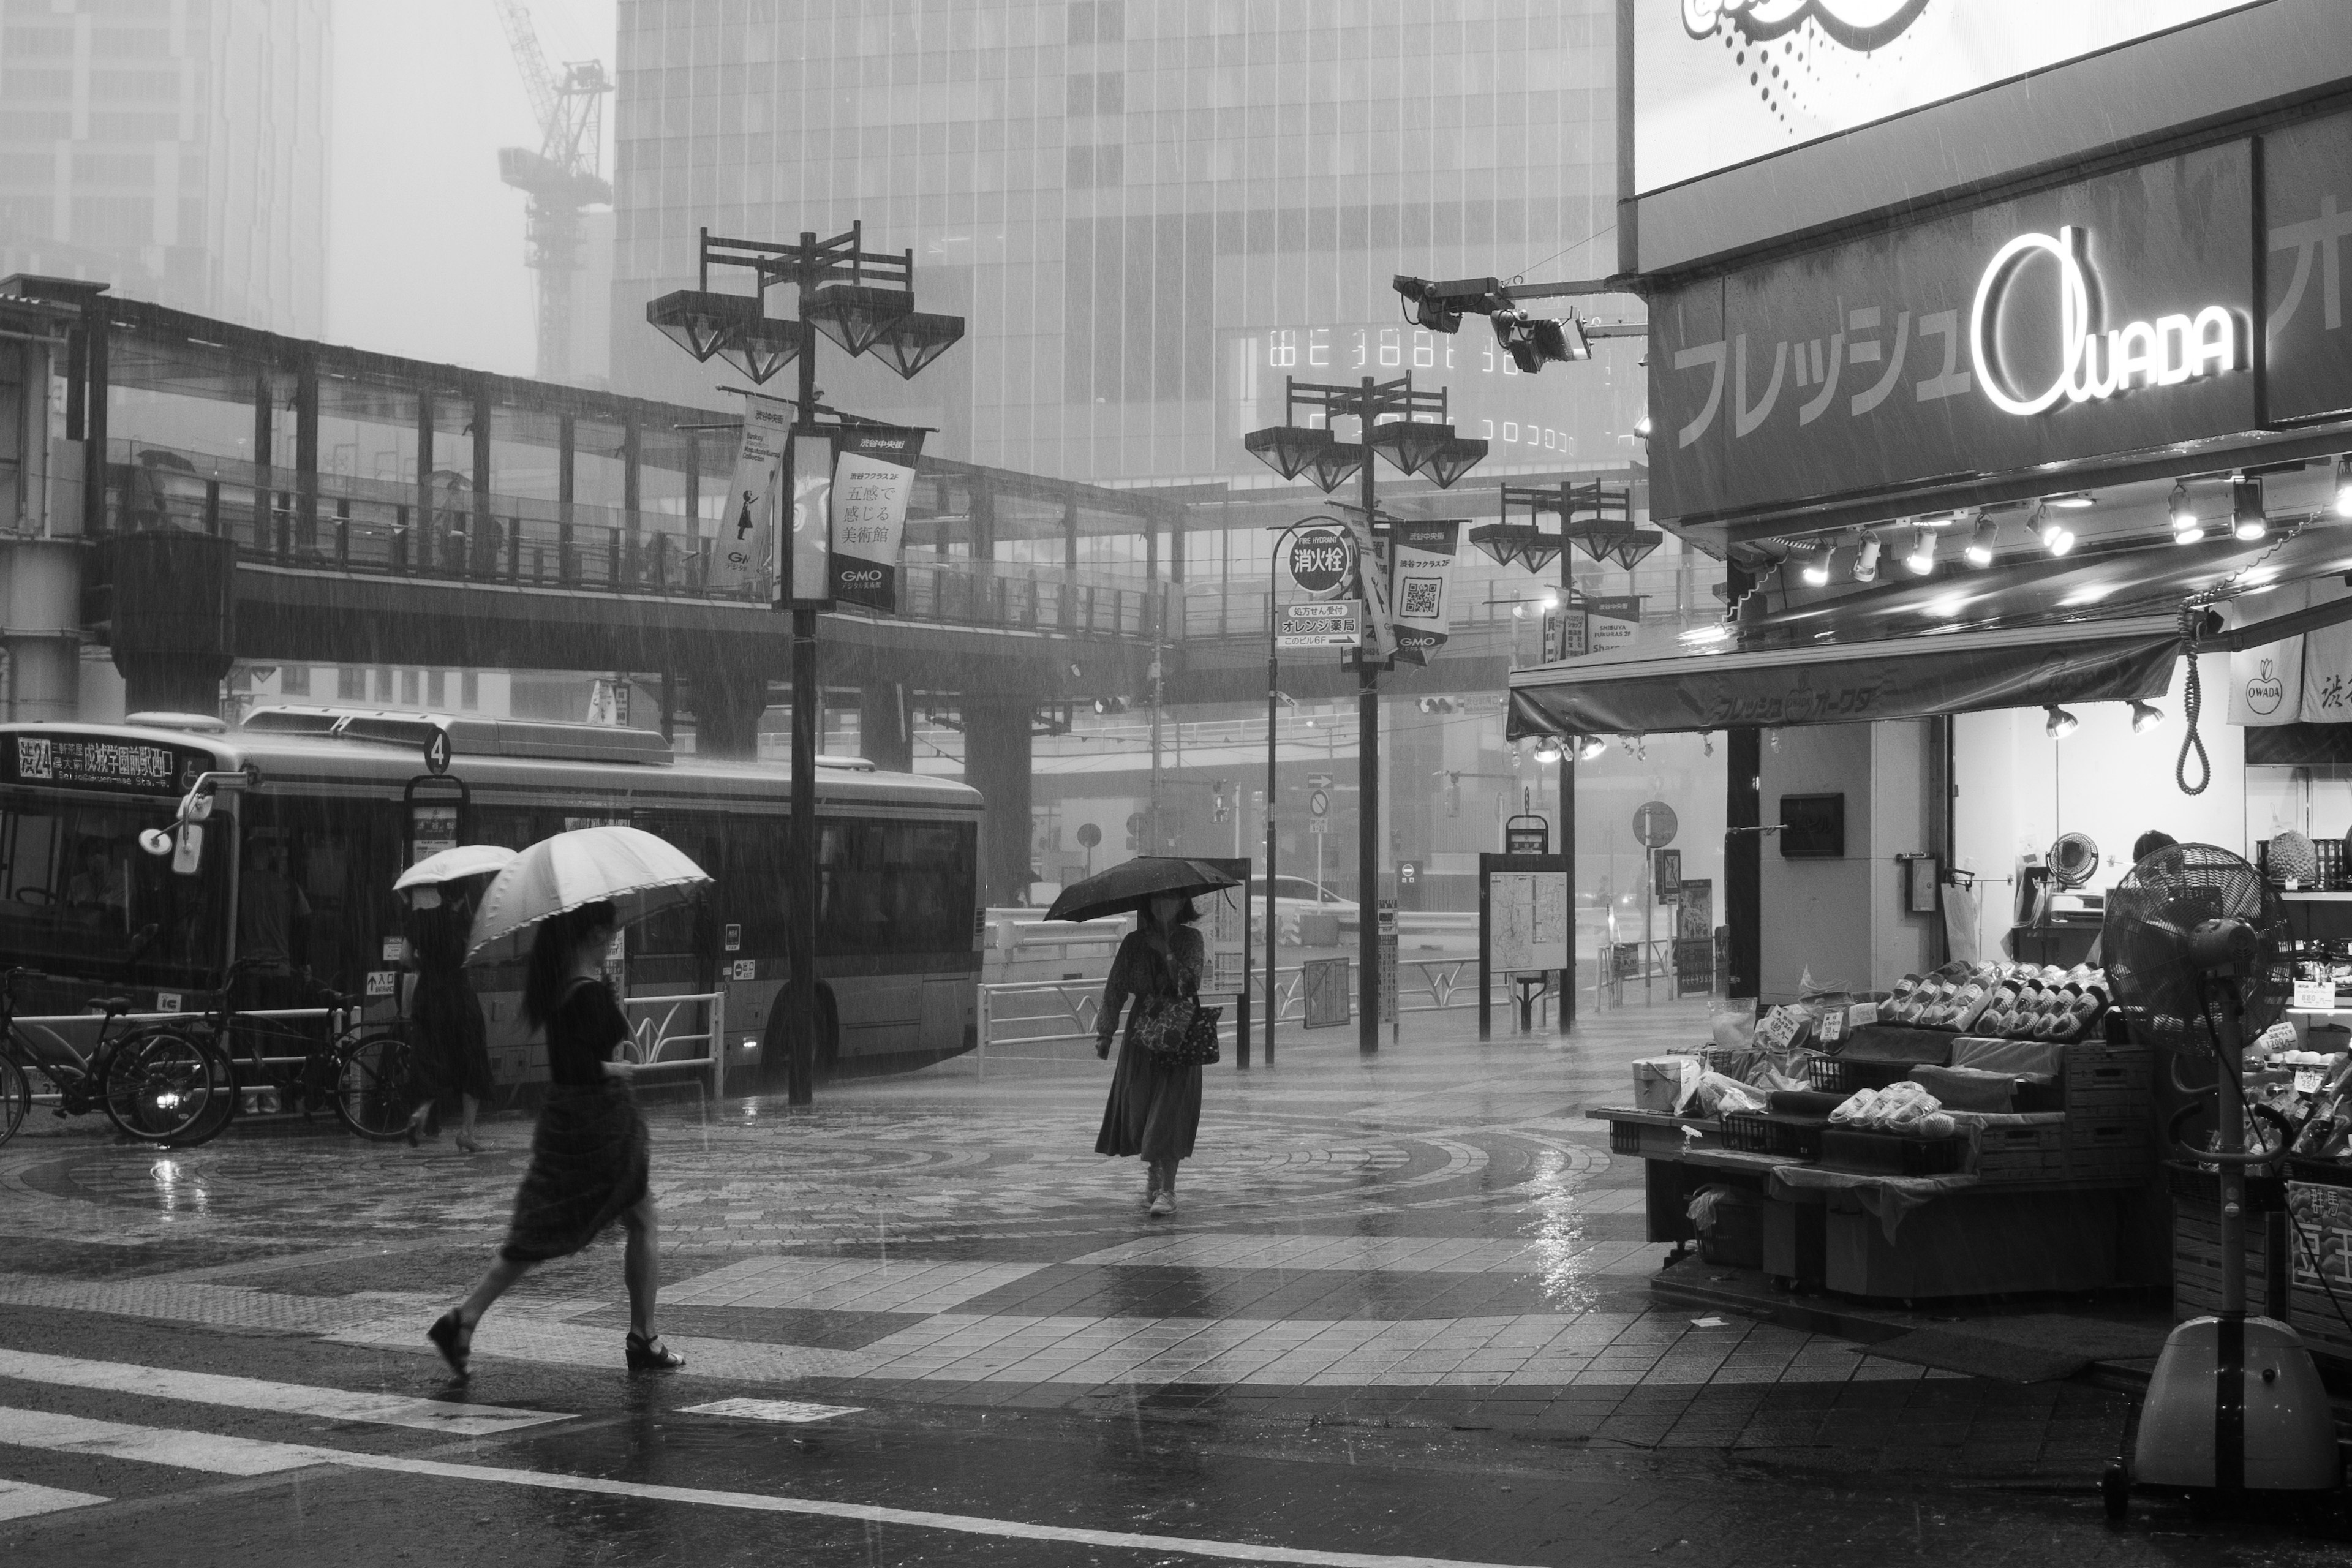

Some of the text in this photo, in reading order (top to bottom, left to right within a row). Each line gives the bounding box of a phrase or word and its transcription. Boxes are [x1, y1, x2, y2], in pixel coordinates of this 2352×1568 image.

[1674, 304, 1972, 450] フレッシュ
[860, 439, 905, 449] 渋谷中央街
[846, 484, 896, 501] 五感で
[843, 505, 889, 522] 感じる
[842, 526, 889, 544] 美術館
[1294, 547, 1344, 573] 消火栓
[841, 570, 882, 582] GMO
[1294, 606, 1343, 616] 処方せん受付
[1282, 619, 1355, 633] オレンジ薬局
[1284, 636, 1327, 646] このビル6F
[1400, 637, 1436, 646] GMO
[2248, 687, 2280, 698] OWADA
[84, 742, 173, 777] 成城学園前駅西口
[378, 974, 394, 985] 入口
[2310, 1188, 2340, 1217] 群馬
